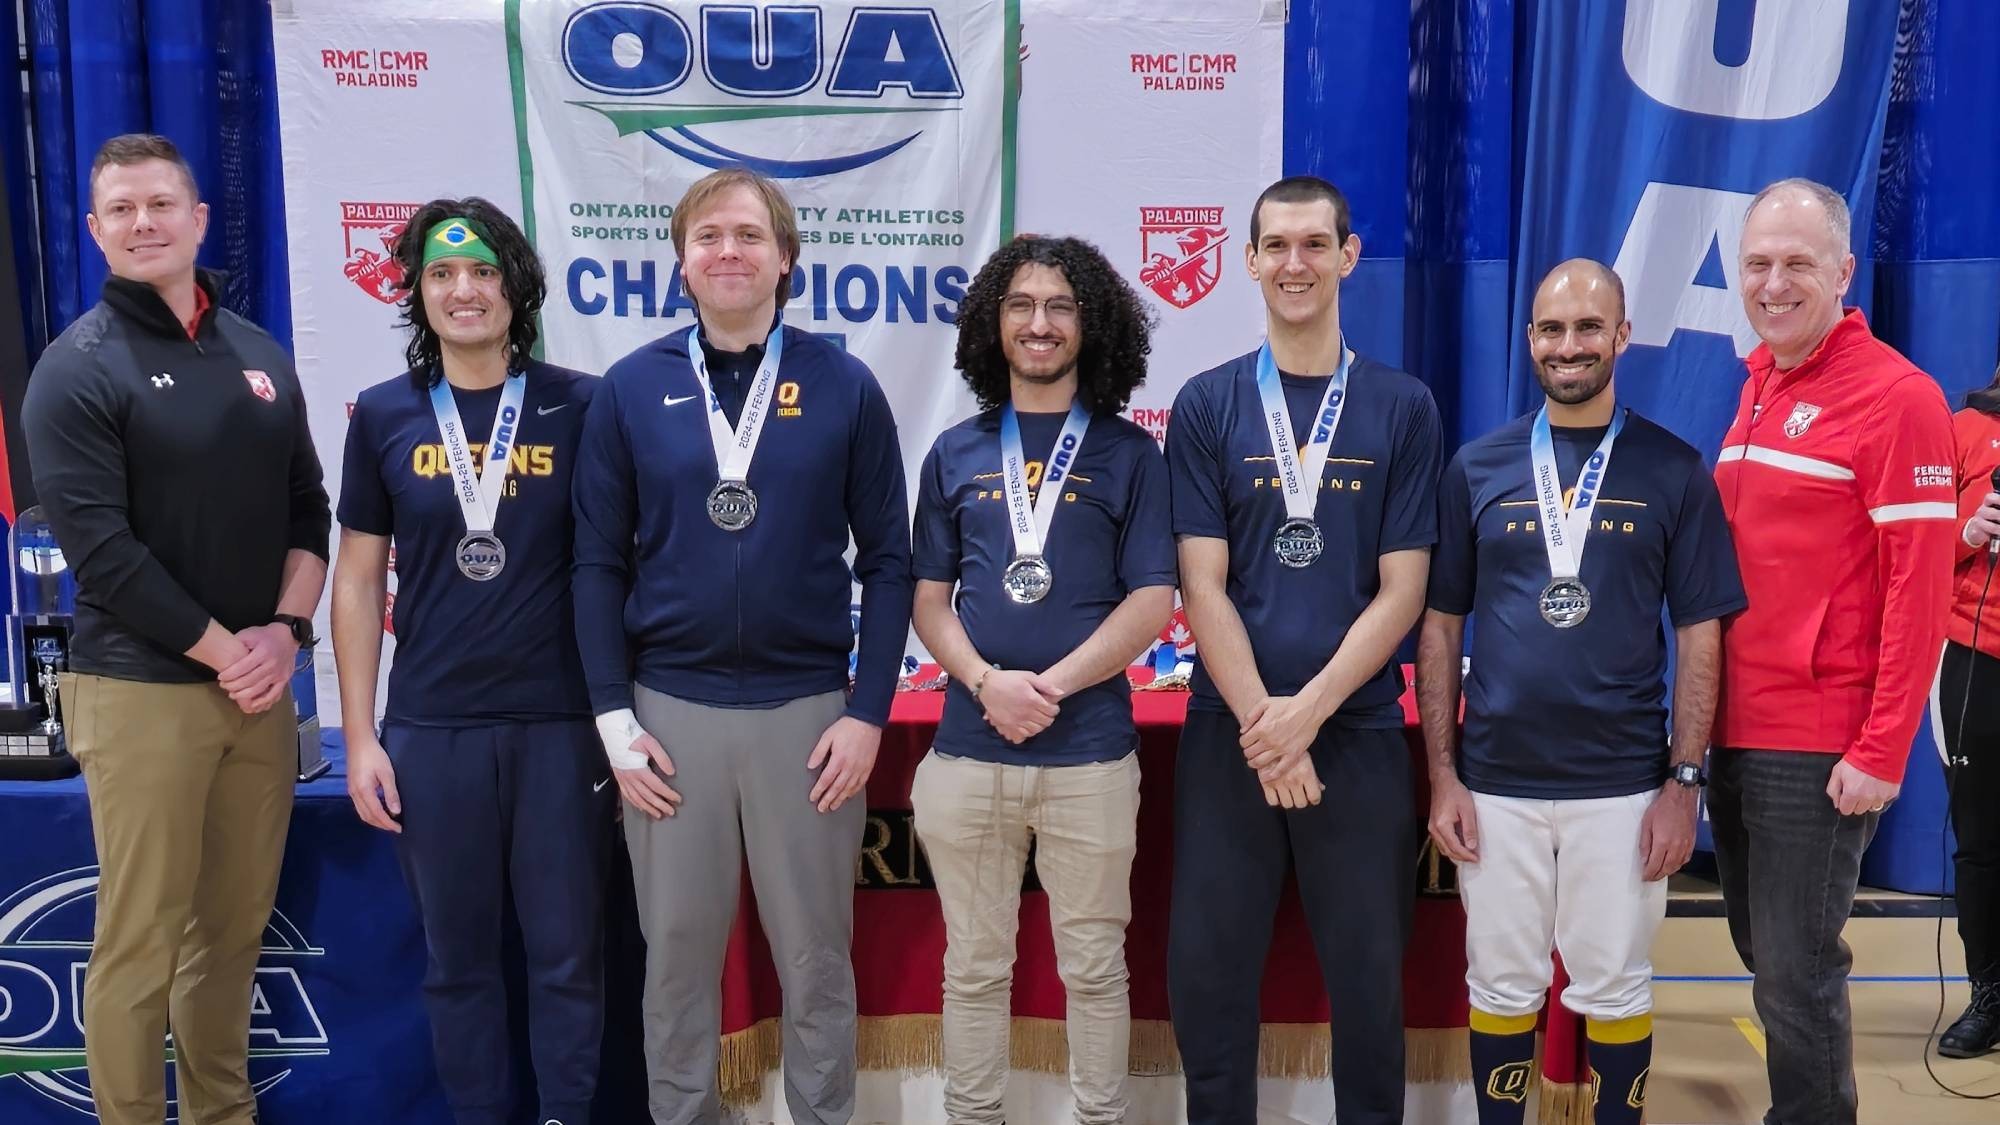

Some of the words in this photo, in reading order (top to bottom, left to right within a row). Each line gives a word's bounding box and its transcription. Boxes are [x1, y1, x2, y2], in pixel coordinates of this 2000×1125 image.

[561, 2, 963, 98] OUA
[336, 72, 418, 87] PALADINS
[1143, 76, 1225, 90] PALADINS
[570, 203, 674, 219] ONTARIO
[837, 209, 964, 224] ATHLETICS
[1145, 210, 1219, 223] PALADINS
[572, 226, 648, 240] SPORTS
[829, 232, 854, 244] DE
[861, 232, 964, 246] L'ONTARIO
[739, 412, 759, 449] 2024-25
[752, 369, 771, 411] FENCING
[1313, 389, 1343, 444] OUA
[445, 422, 464, 463] FENCING
[490, 406, 517, 461] OUA
[1271, 411, 1288, 453] FENCING
[1046, 433, 1077, 482] OUA
[1283, 455, 1299, 494] 2024-25
[456, 464, 476, 503] 2024-25
[1255, 478, 1361, 490] FEING
[1540, 465, 1554, 506] FENCING
[1575, 451, 1605, 509] OUA
[1013, 496, 1029, 533] 2024-25
[1507, 520, 1634, 532] FEING
[1548, 507, 1563, 547] 2024-25
